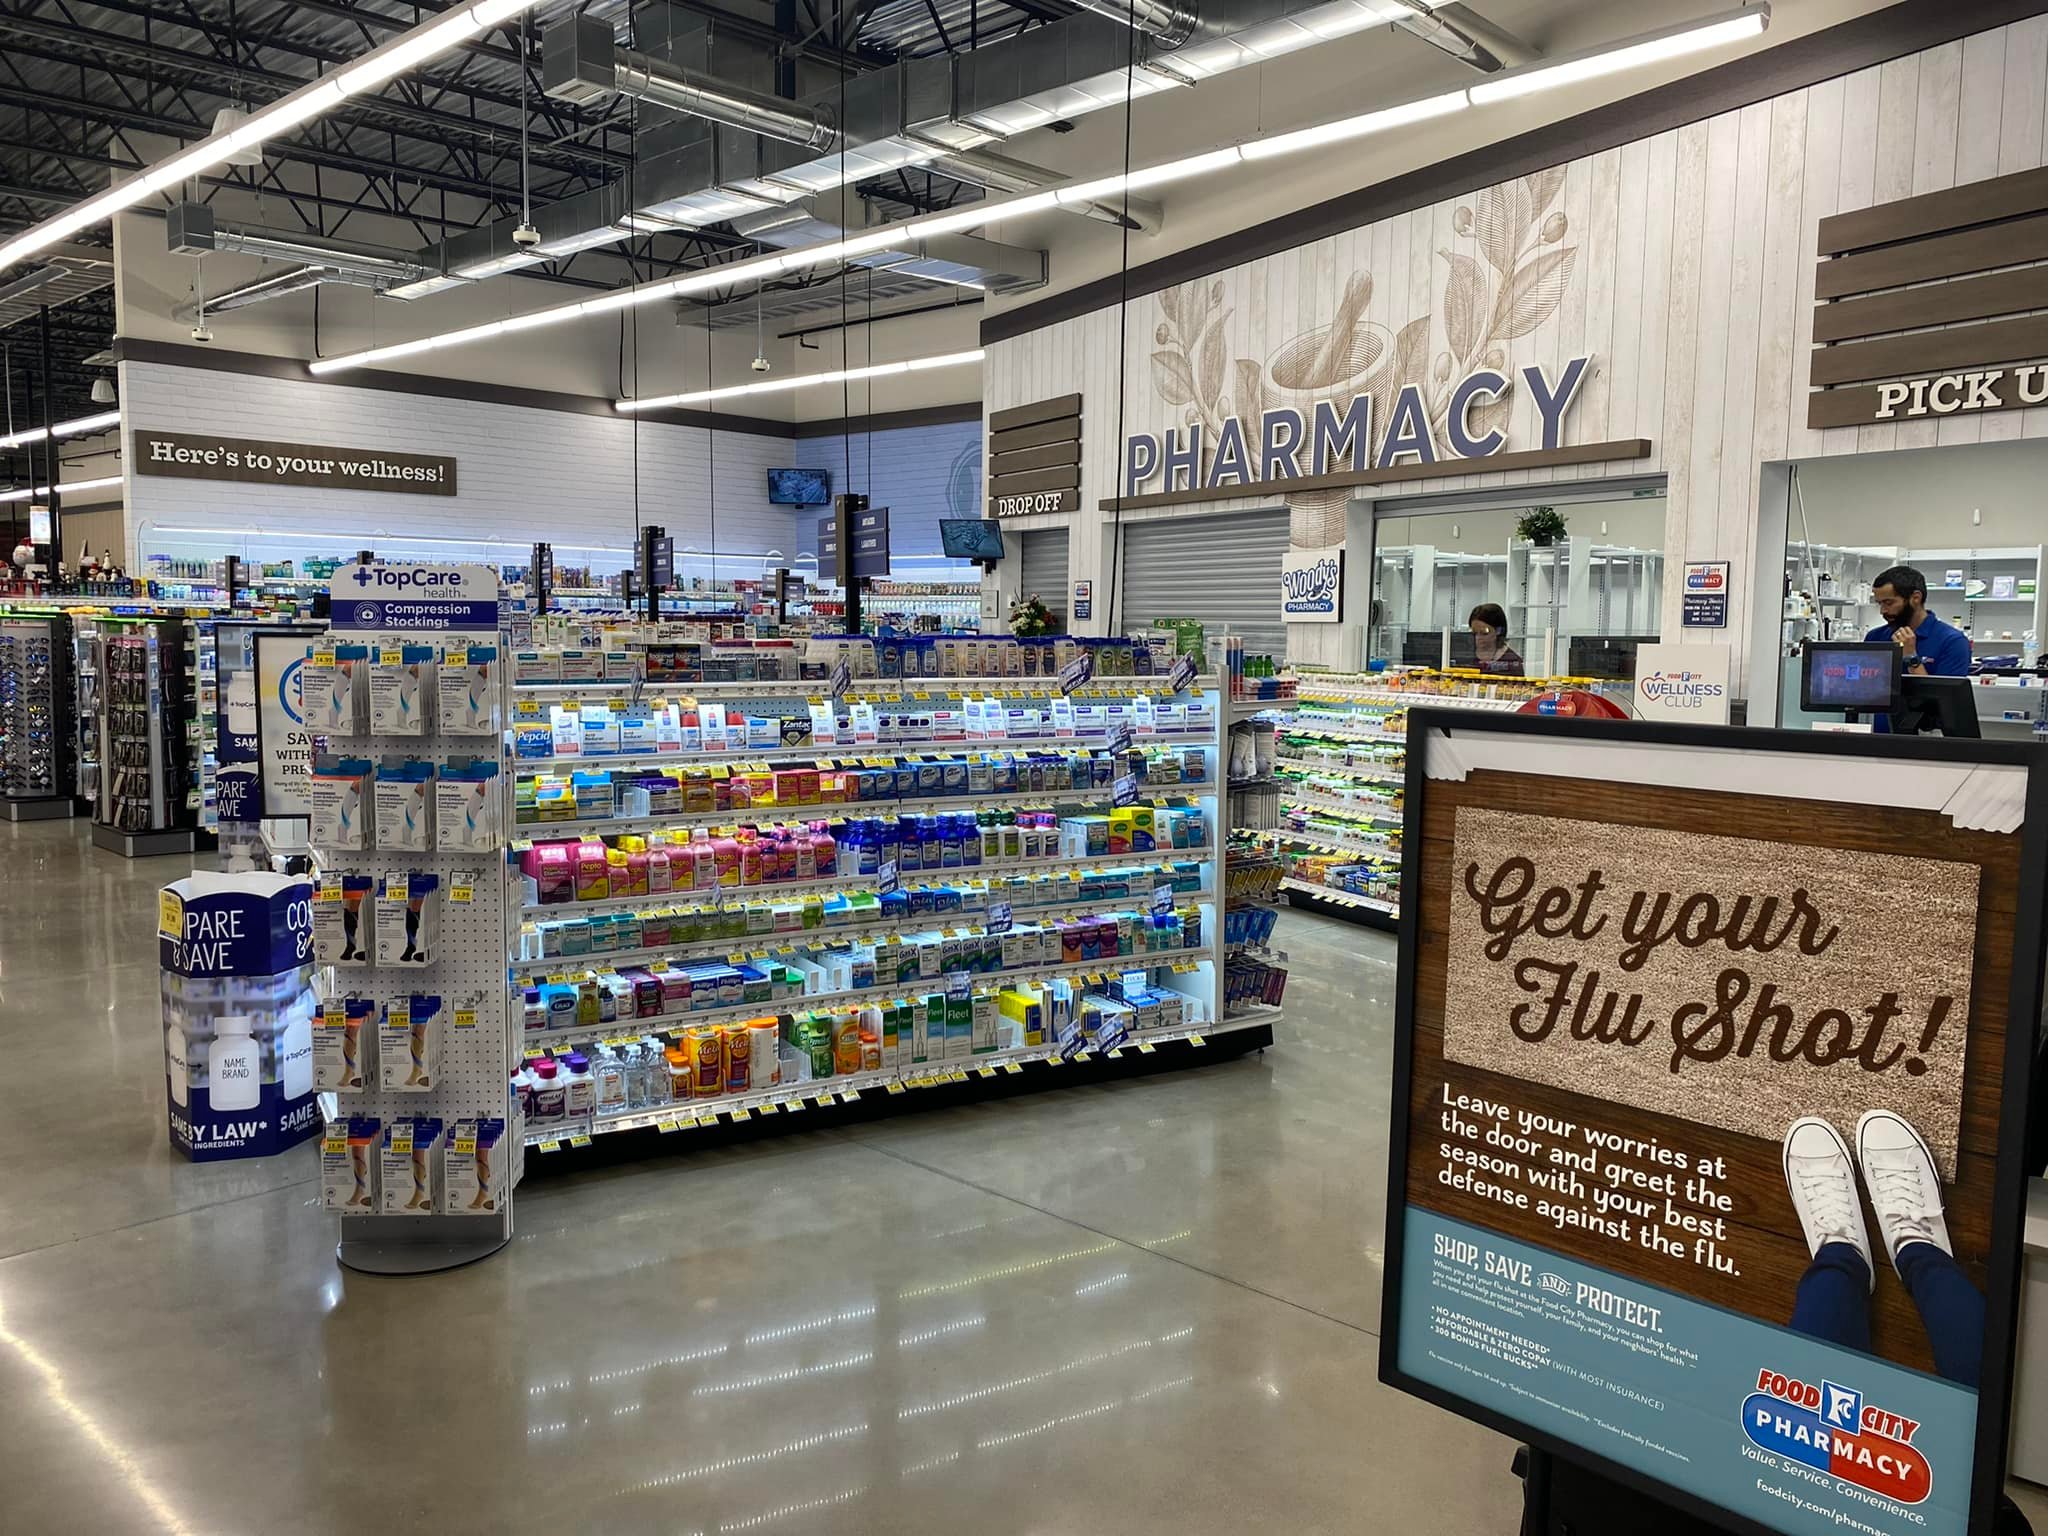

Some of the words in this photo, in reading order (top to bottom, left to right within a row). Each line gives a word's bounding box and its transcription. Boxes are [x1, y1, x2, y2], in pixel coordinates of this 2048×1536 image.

[1875, 370, 2003, 418] PICK
[2014, 365, 2048, 403] U
[1126, 354, 1596, 499] PHARMACY
[150, 441, 240, 467] Here's
[245, 450, 272, 469] to
[276, 457, 335, 475] your
[339, 460, 446, 482] wellness!
[998, 496, 1033, 516] DROP
[1035, 492, 1062, 512] OFF
[373, 569, 461, 590] TopCare
[423, 587, 461, 599] health
[1283, 558, 1337, 601] Woody's
[385, 603, 471, 618] Compression
[1287, 602, 1330, 611] PHARMACY
[385, 616, 449, 629] Stockings
[1646, 683, 1723, 696] WELLNESS
[1664, 696, 1702, 708] CLUB
[518, 730, 550, 743] Pepcid
[783, 720, 810, 729] Zantac
[234, 737, 257, 748] SAM
[216, 781, 248, 799] PARE
[217, 799, 241, 817] AVE
[581, 862, 602, 871] Pepto
[183, 909, 245, 940] PARE
[1465, 856, 1607, 961] Get
[1620, 888, 1839, 971] your
[183, 941, 233, 971] SAVE
[928, 1008, 943, 1017] Fleet
[947, 1009, 968, 1020] Fleet
[1510, 958, 1655, 1043] Flu
[1670, 968, 1954, 1077] Shot!
[222, 1068, 249, 1079] BRAND
[224, 1057, 247, 1068] NAME
[280, 1101, 314, 1132] SAME
[1442, 1082, 1510, 1121] Leave
[1518, 1109, 1576, 1137] your
[1583, 1125, 1688, 1169] worries
[1697, 1155, 1727, 1180] at
[187, 1123, 206, 1141] BY
[194, 1139, 245, 1150] INGREDIENTS
[1441, 1110, 1478, 1139] the
[1486, 1122, 1542, 1156] door
[1549, 1147, 1597, 1173] and
[1605, 1162, 1676, 1196] greet
[1685, 1178, 1733, 1212] the
[1440, 1142, 1519, 1179] season
[1527, 1166, 1585, 1199] with
[1593, 1187, 1656, 1218] your
[1664, 1199, 1727, 1241] best
[1438, 1162, 1528, 1209] defense
[1536, 1199, 1631, 1242] against
[1640, 1224, 1685, 1259] the
[1694, 1238, 1741, 1277] flu.
[1432, 1278, 1440, 1287] all
[1448, 1285, 1460, 1294] one
[1461, 1289, 1496, 1308] convenient
[1434, 1233, 1479, 1271] SHOP,
[1485, 1250, 1532, 1287] SAVE
[1541, 1275, 1567, 1294] AND
[1575, 1281, 1663, 1333] PROTECT.
[1432, 1270, 1444, 1279] you
[1445, 1274, 1461, 1285] need
[1462, 1279, 1474, 1289] and
[1475, 1283, 1489, 1296] help
[1490, 1290, 1514, 1305] protect
[1515, 1299, 1544, 1316] yourself,
[1545, 1311, 1561, 1321] your
[1562, 1315, 1587, 1332] family,
[1588, 1325, 1601, 1336] and
[1602, 1331, 1619, 1342] your
[1660, 1350, 1685, 1367] health
[1433, 1258, 1452, 1272] When
[1453, 1268, 1465, 1277] you
[1478, 1277, 1492, 1287] your
[1494, 1280, 1503, 1290] flu
[1505, 1285, 1519, 1297] shot
[1528, 1293, 1540, 1304] the
[1541, 1297, 1559, 1311] Food
[1560, 1304, 1576, 1318] City
[1577, 1310, 1615, 1332] Pharmacy,
[1616, 1326, 1630, 1336] you
[1631, 1331, 1645, 1342] can
[1646, 1336, 1664, 1350] shop
[1666, 1341, 1677, 1353] for
[1679, 1347, 1698, 1361] what
[1436, 1306, 1449, 1316] NO
[1450, 1311, 1511, 1340] APPOINTMENT
[1435, 1325, 1449, 1337] 300
[1450, 1331, 1480, 1349] BONUS
[1481, 1343, 1502, 1359] FUEL
[1435, 1316, 1489, 1343] AFFORDABLE
[1490, 1336, 1496, 1346] &
[1497, 1339, 1520, 1354] ZERO
[1521, 1349, 1552, 1367] COPAY
[1552, 1360, 1577, 1377] (WITH
[1578, 1371, 1604, 1387] MOST
[1605, 1381, 1665, 1411] INSURANCE)
[1756, 1368, 1820, 1409] FOOD
[1861, 1405, 1921, 1443] CITY
[1756, 1409, 1912, 1481] PHARMACY
[1741, 1444, 1778, 1469] Value.
[1782, 1460, 1832, 1490] Service.
[1836, 1482, 1927, 1527] Convenience.
[1756, 1478, 1892, 1536] foodcity.com/pharmac
